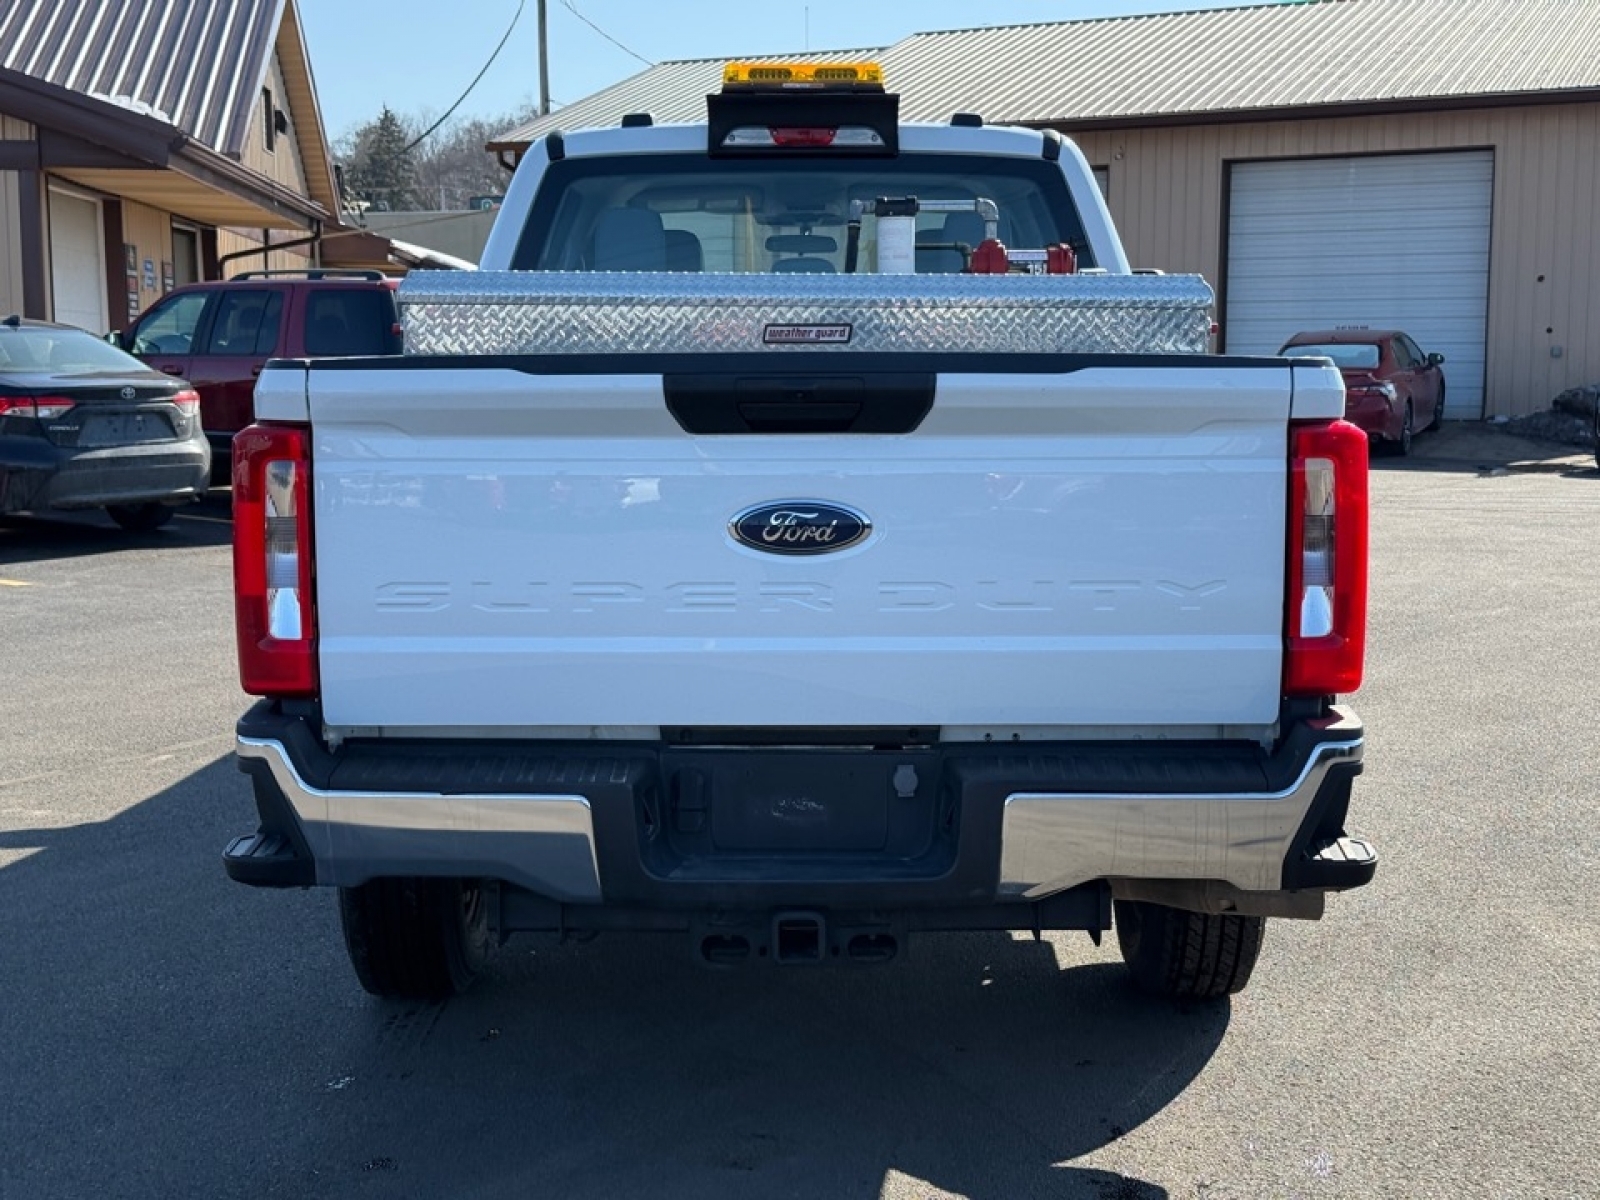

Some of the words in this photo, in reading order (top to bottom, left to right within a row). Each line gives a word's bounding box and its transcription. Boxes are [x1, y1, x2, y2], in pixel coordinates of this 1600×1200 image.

[768, 327, 813, 338] weather
[815, 327, 846, 340] guard
[762, 511, 838, 541] Ford
[375, 580, 833, 612] SUPER
[879, 580, 1227, 612] DUTY
